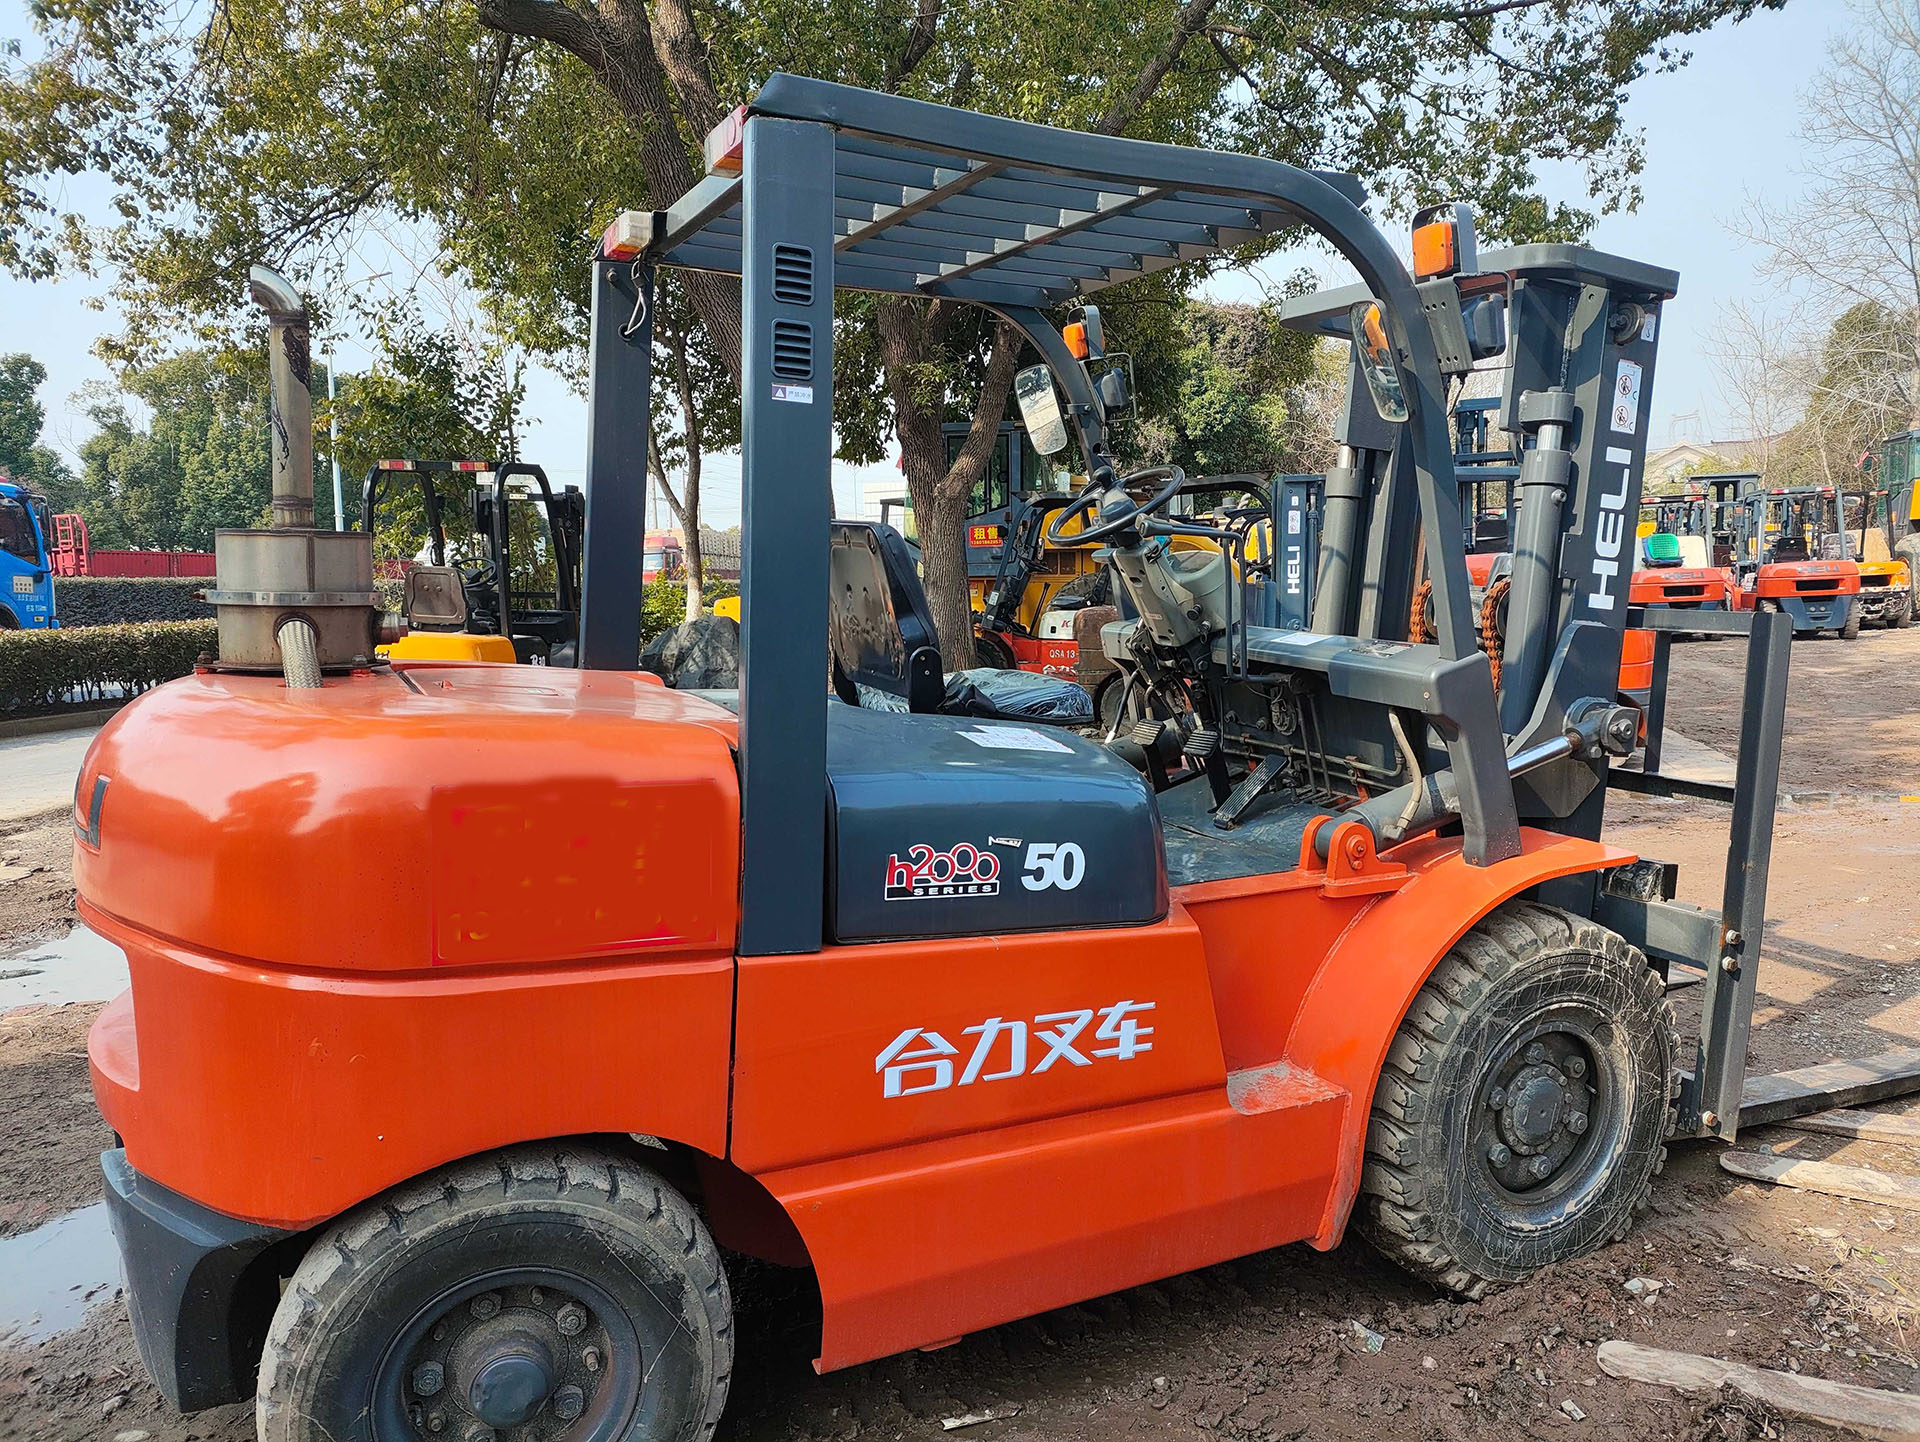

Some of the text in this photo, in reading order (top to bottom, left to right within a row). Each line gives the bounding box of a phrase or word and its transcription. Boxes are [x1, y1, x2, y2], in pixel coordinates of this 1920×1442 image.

[1587, 446, 1633, 610] HELI
[1287, 545, 1301, 594] HELI
[912, 883, 994, 897] SERIES
[1020, 842, 1086, 892] 50
[875, 999, 1156, 1099] 合力叉车
